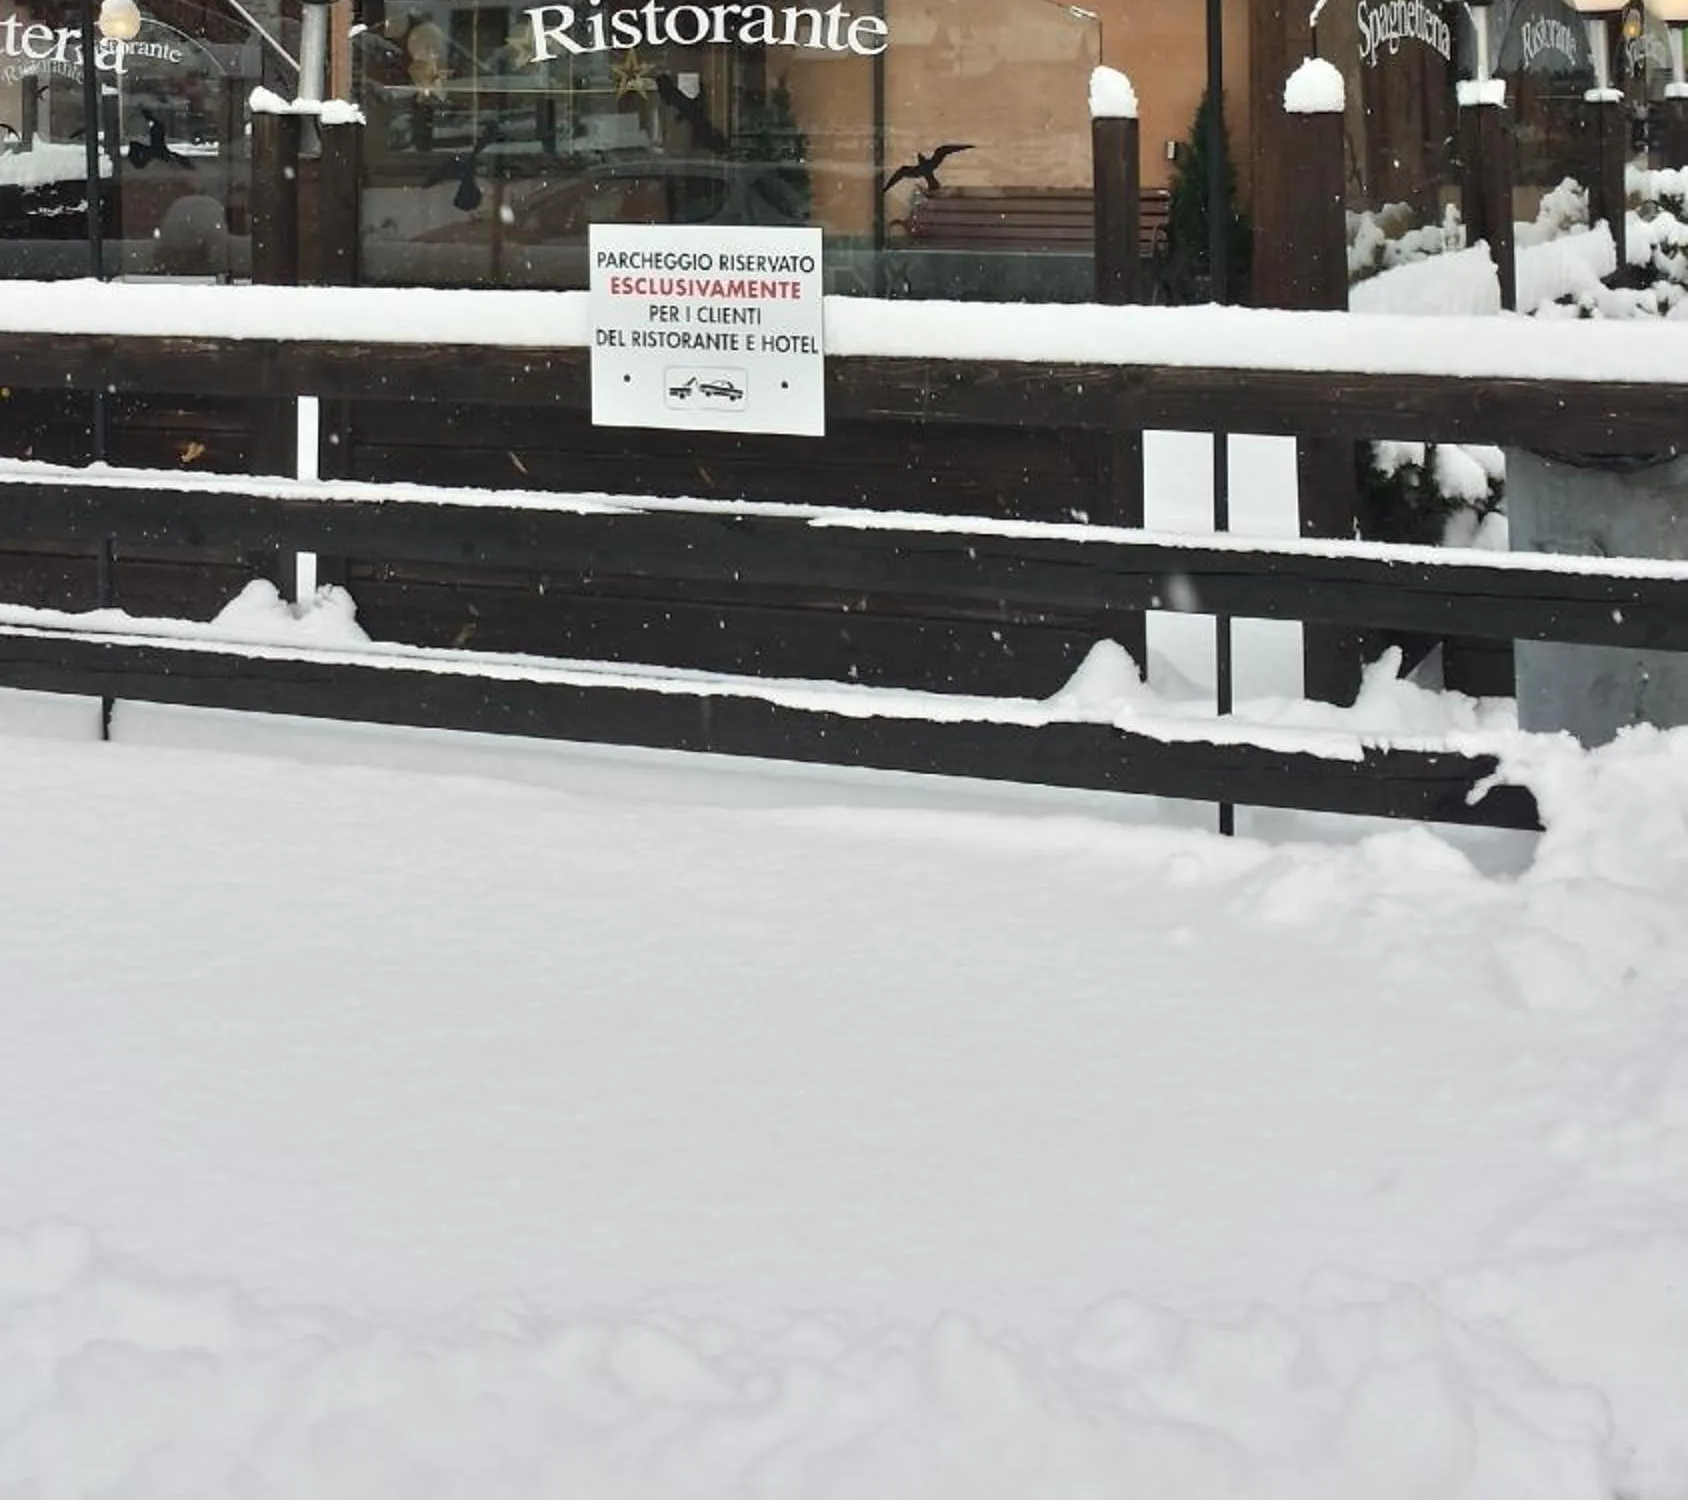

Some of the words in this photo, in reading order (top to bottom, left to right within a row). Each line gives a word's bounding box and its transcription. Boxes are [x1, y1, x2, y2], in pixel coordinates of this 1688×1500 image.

[597, 251, 712, 272] PARCHEGGIO
[719, 254, 815, 274] RISERVATO
[611, 277, 801, 299] ESCLUSIVAMENTE
[649, 305, 680, 323] PER
[685, 306, 691, 323] I
[697, 307, 762, 325] CLIENTI
[596, 329, 625, 347] DEL
[632, 331, 739, 351] RISTORANTE
[746, 334, 756, 351] E
[762, 335, 819, 354] HOTEL
